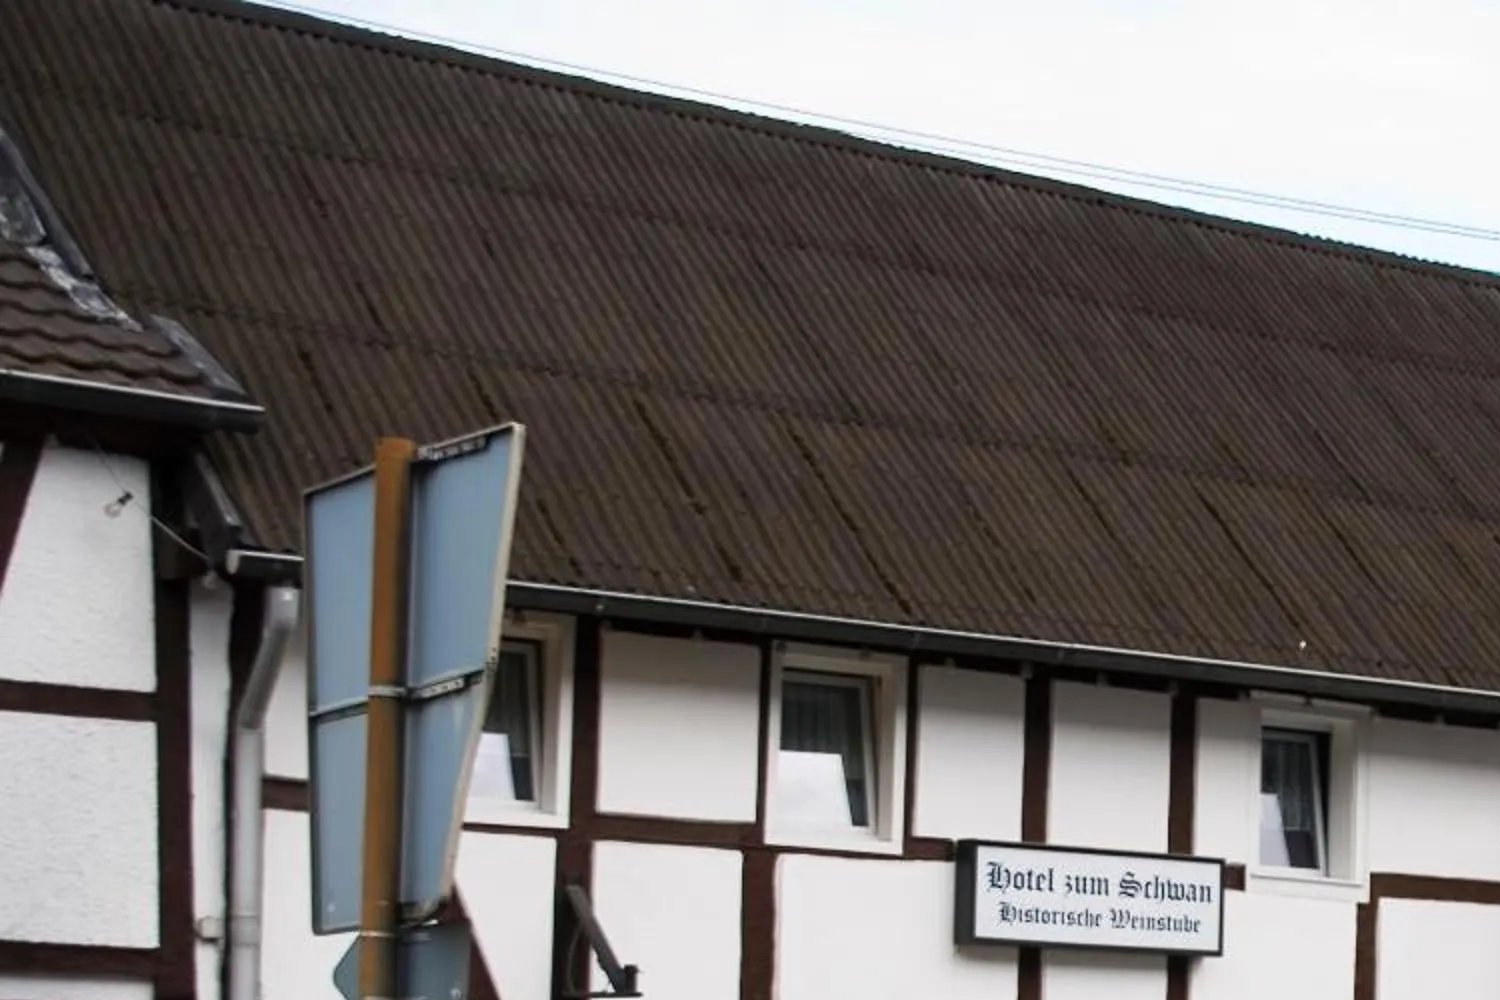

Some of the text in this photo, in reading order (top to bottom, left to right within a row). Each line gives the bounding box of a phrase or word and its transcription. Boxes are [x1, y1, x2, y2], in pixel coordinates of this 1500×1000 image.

[986, 861, 1213, 904] Hotel zum Schwan
[998, 901, 1201, 934] Historische Weinstube
